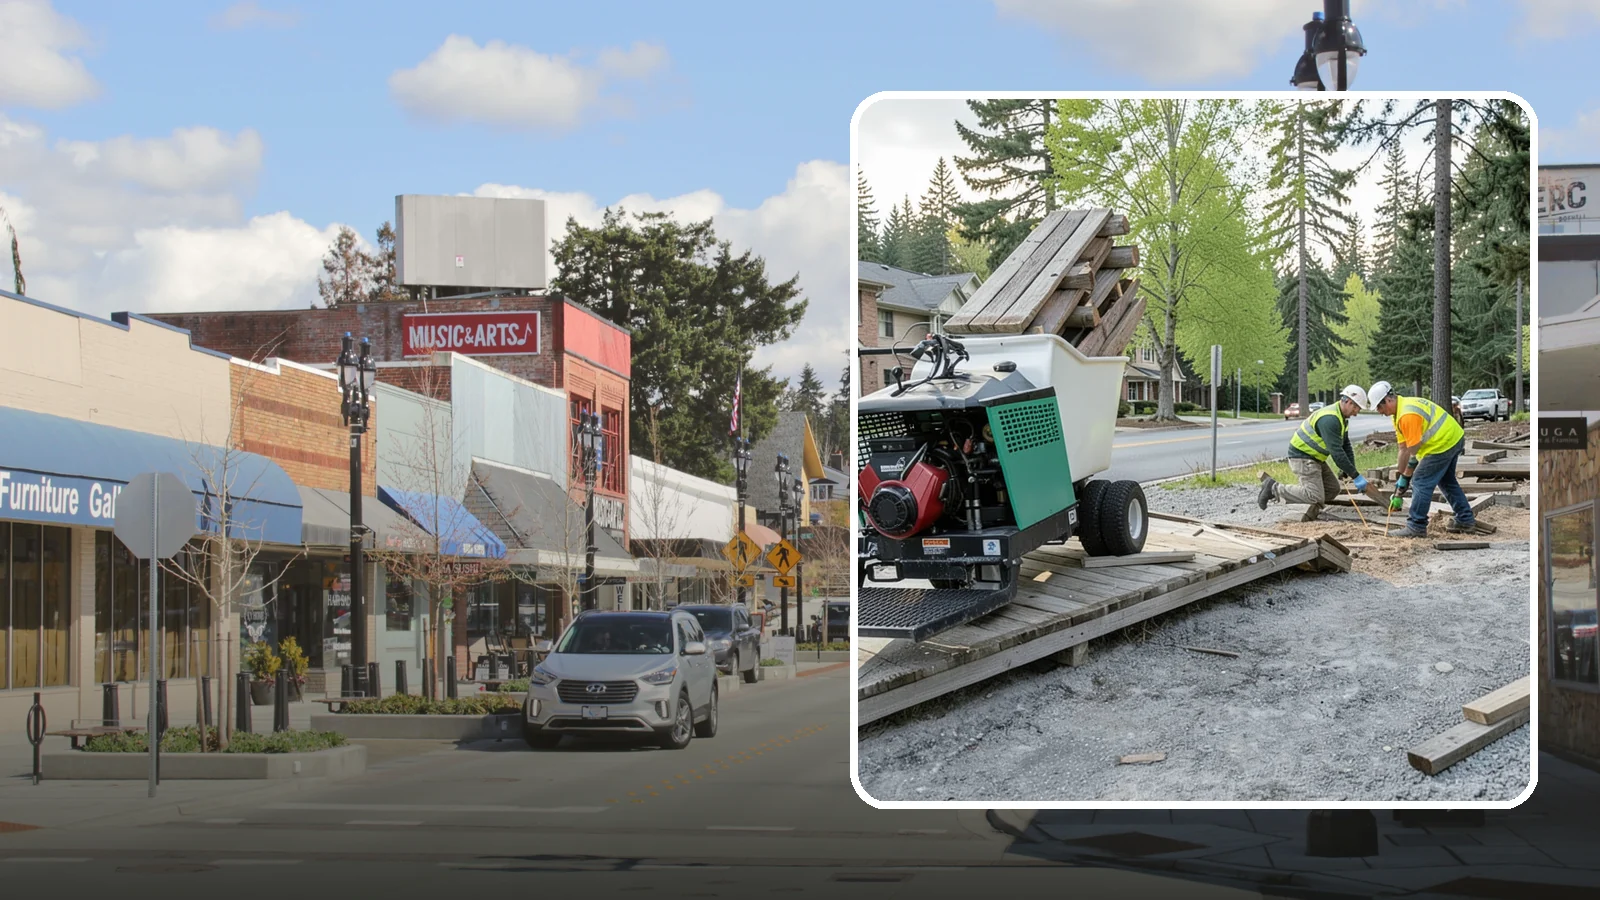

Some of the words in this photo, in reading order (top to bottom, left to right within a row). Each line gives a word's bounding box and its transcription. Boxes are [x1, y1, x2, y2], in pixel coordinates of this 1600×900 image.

[409, 322, 519, 349] MUSIC&ARTS
[0, 471, 79, 515] Furniture
[90, 482, 121, 519] Gal
